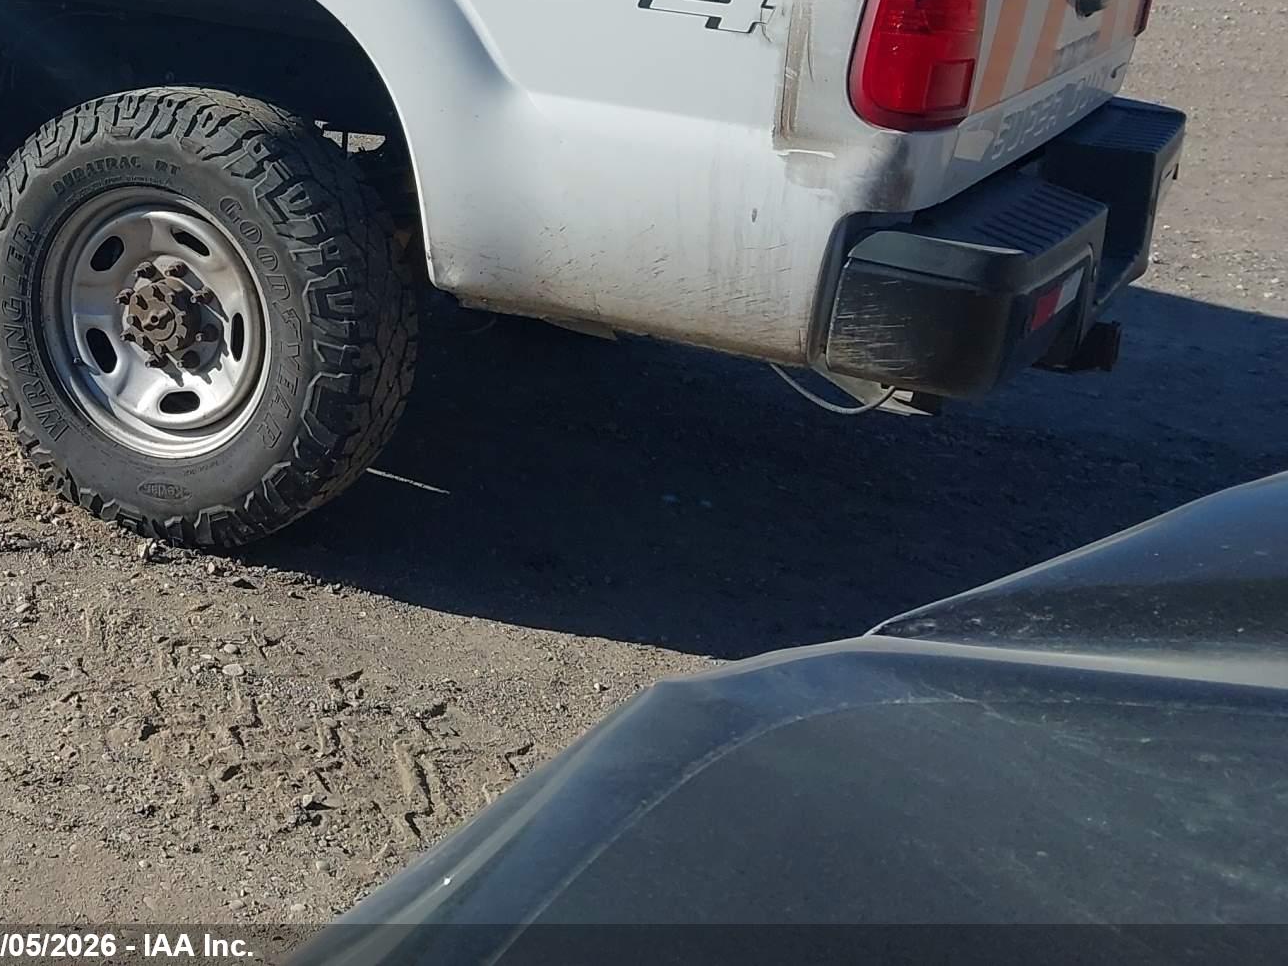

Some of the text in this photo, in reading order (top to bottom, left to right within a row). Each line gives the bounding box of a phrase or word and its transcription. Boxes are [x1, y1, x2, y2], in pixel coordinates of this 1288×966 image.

[52, 155, 142, 195] DURATRAC
[154, 159, 181, 176] RT
[991, 92, 1060, 160] SUPER
[1, 221, 71, 442] WRANGLER
[219, 197, 304, 449] GOODYEAR
